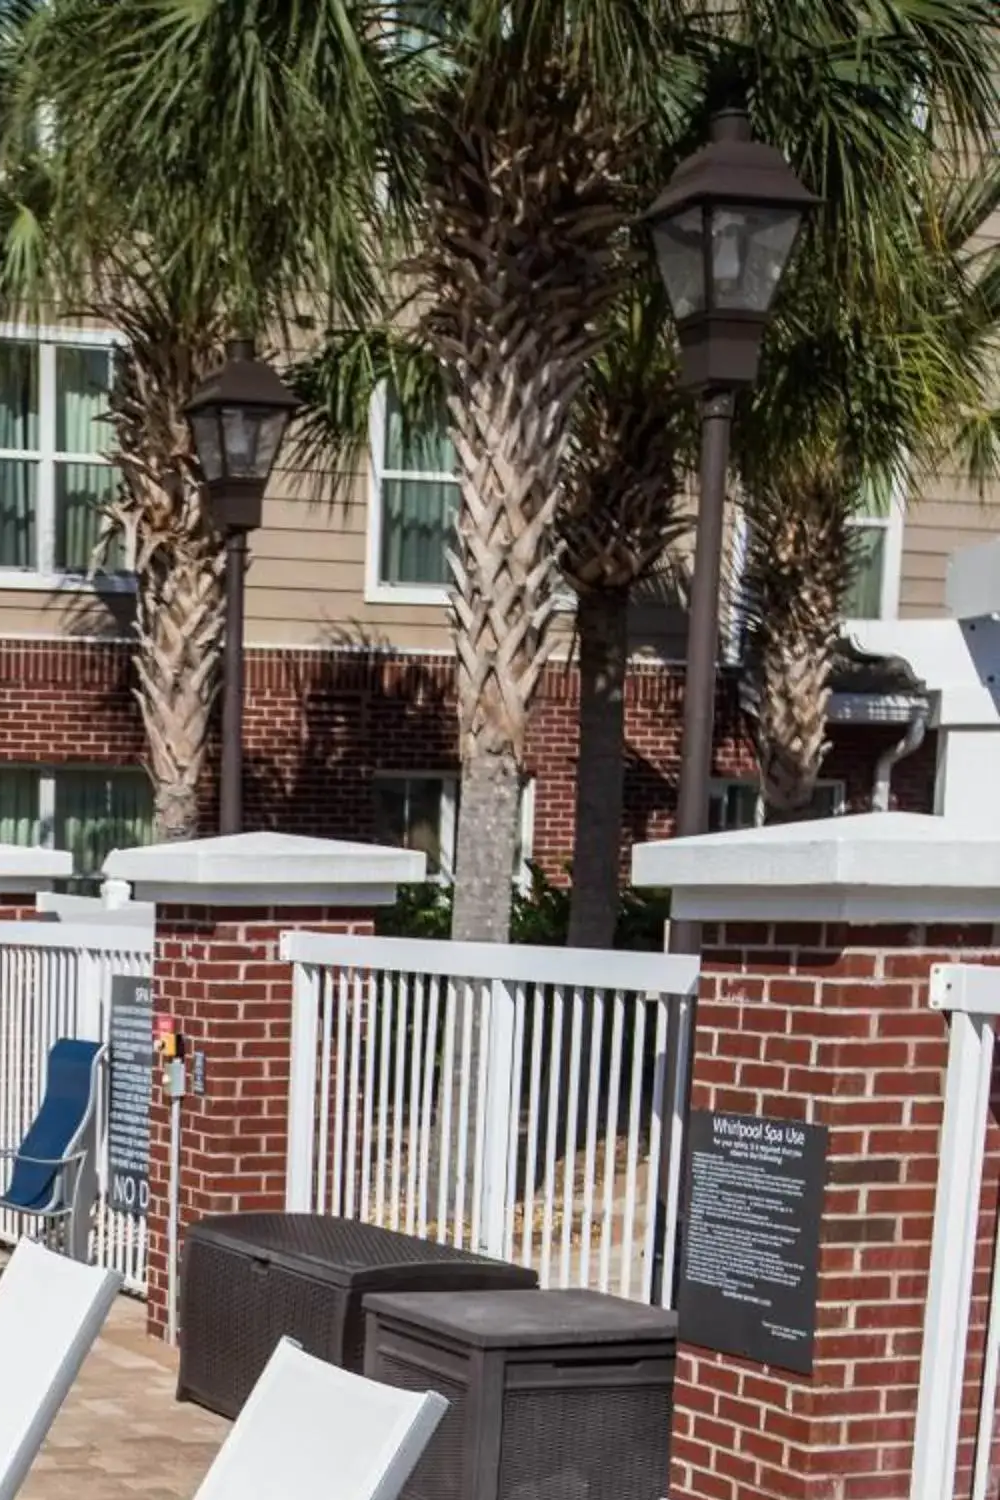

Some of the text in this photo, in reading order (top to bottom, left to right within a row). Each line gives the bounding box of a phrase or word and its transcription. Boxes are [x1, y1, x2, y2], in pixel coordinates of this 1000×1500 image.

[713, 1116, 805, 1146] Whirlpool Spa Use
[113, 1174, 136, 1205] NO
